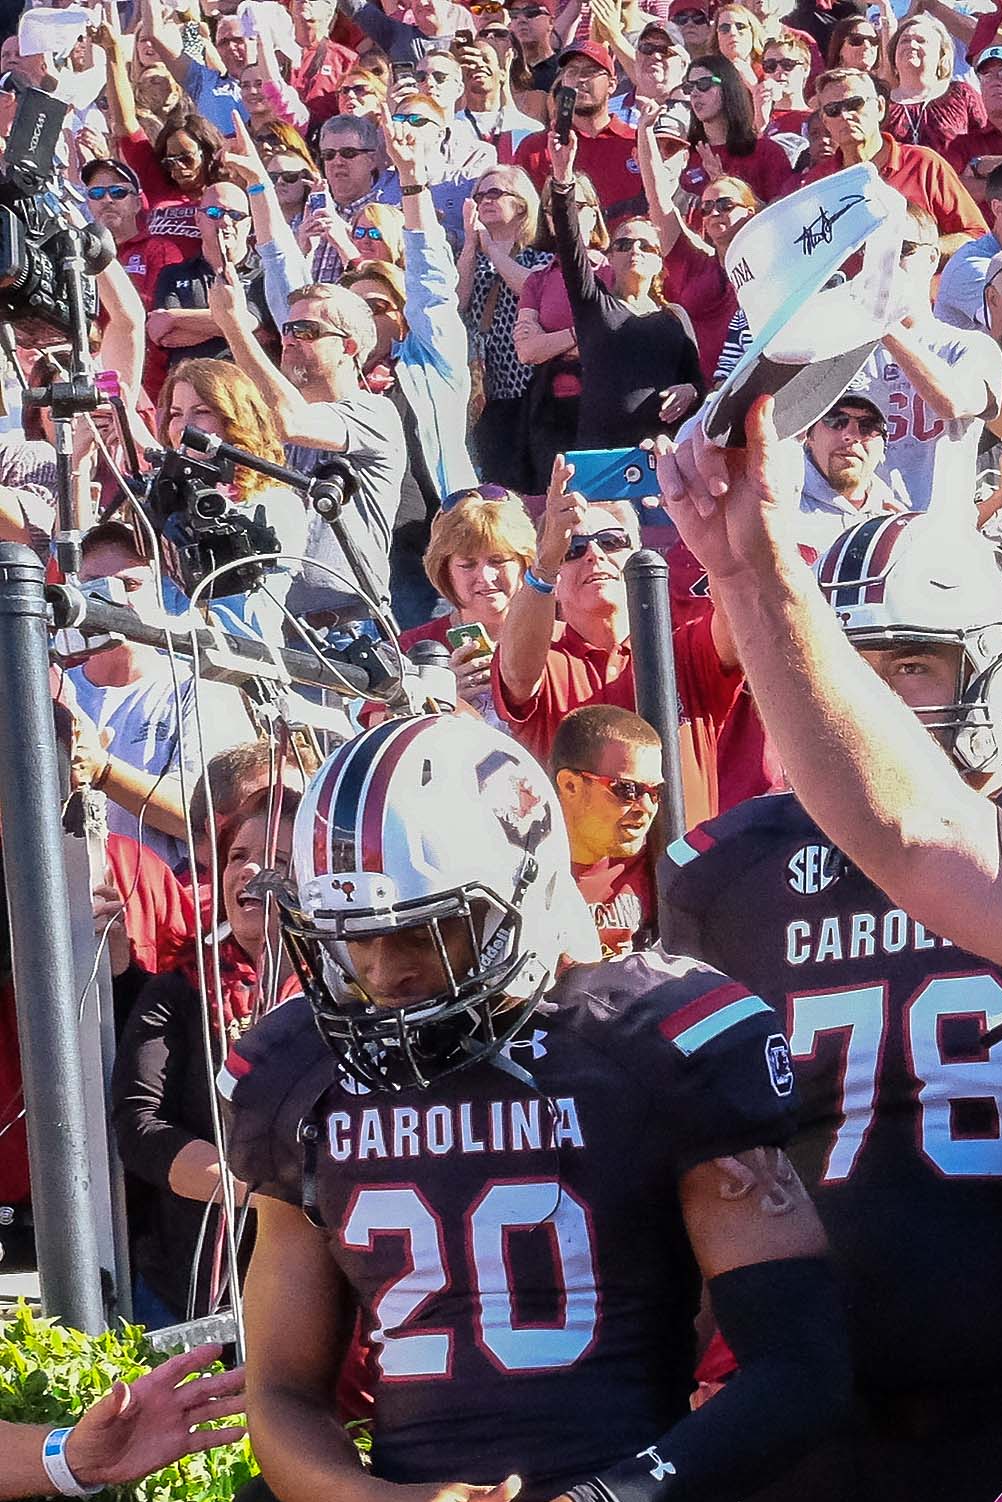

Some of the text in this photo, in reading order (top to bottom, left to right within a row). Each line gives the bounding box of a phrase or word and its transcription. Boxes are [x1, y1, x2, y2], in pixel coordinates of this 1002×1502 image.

[786, 908, 952, 965] CAROL
[327, 1096, 586, 1163] CAROLINA
[340, 1176, 603, 1383] 20
